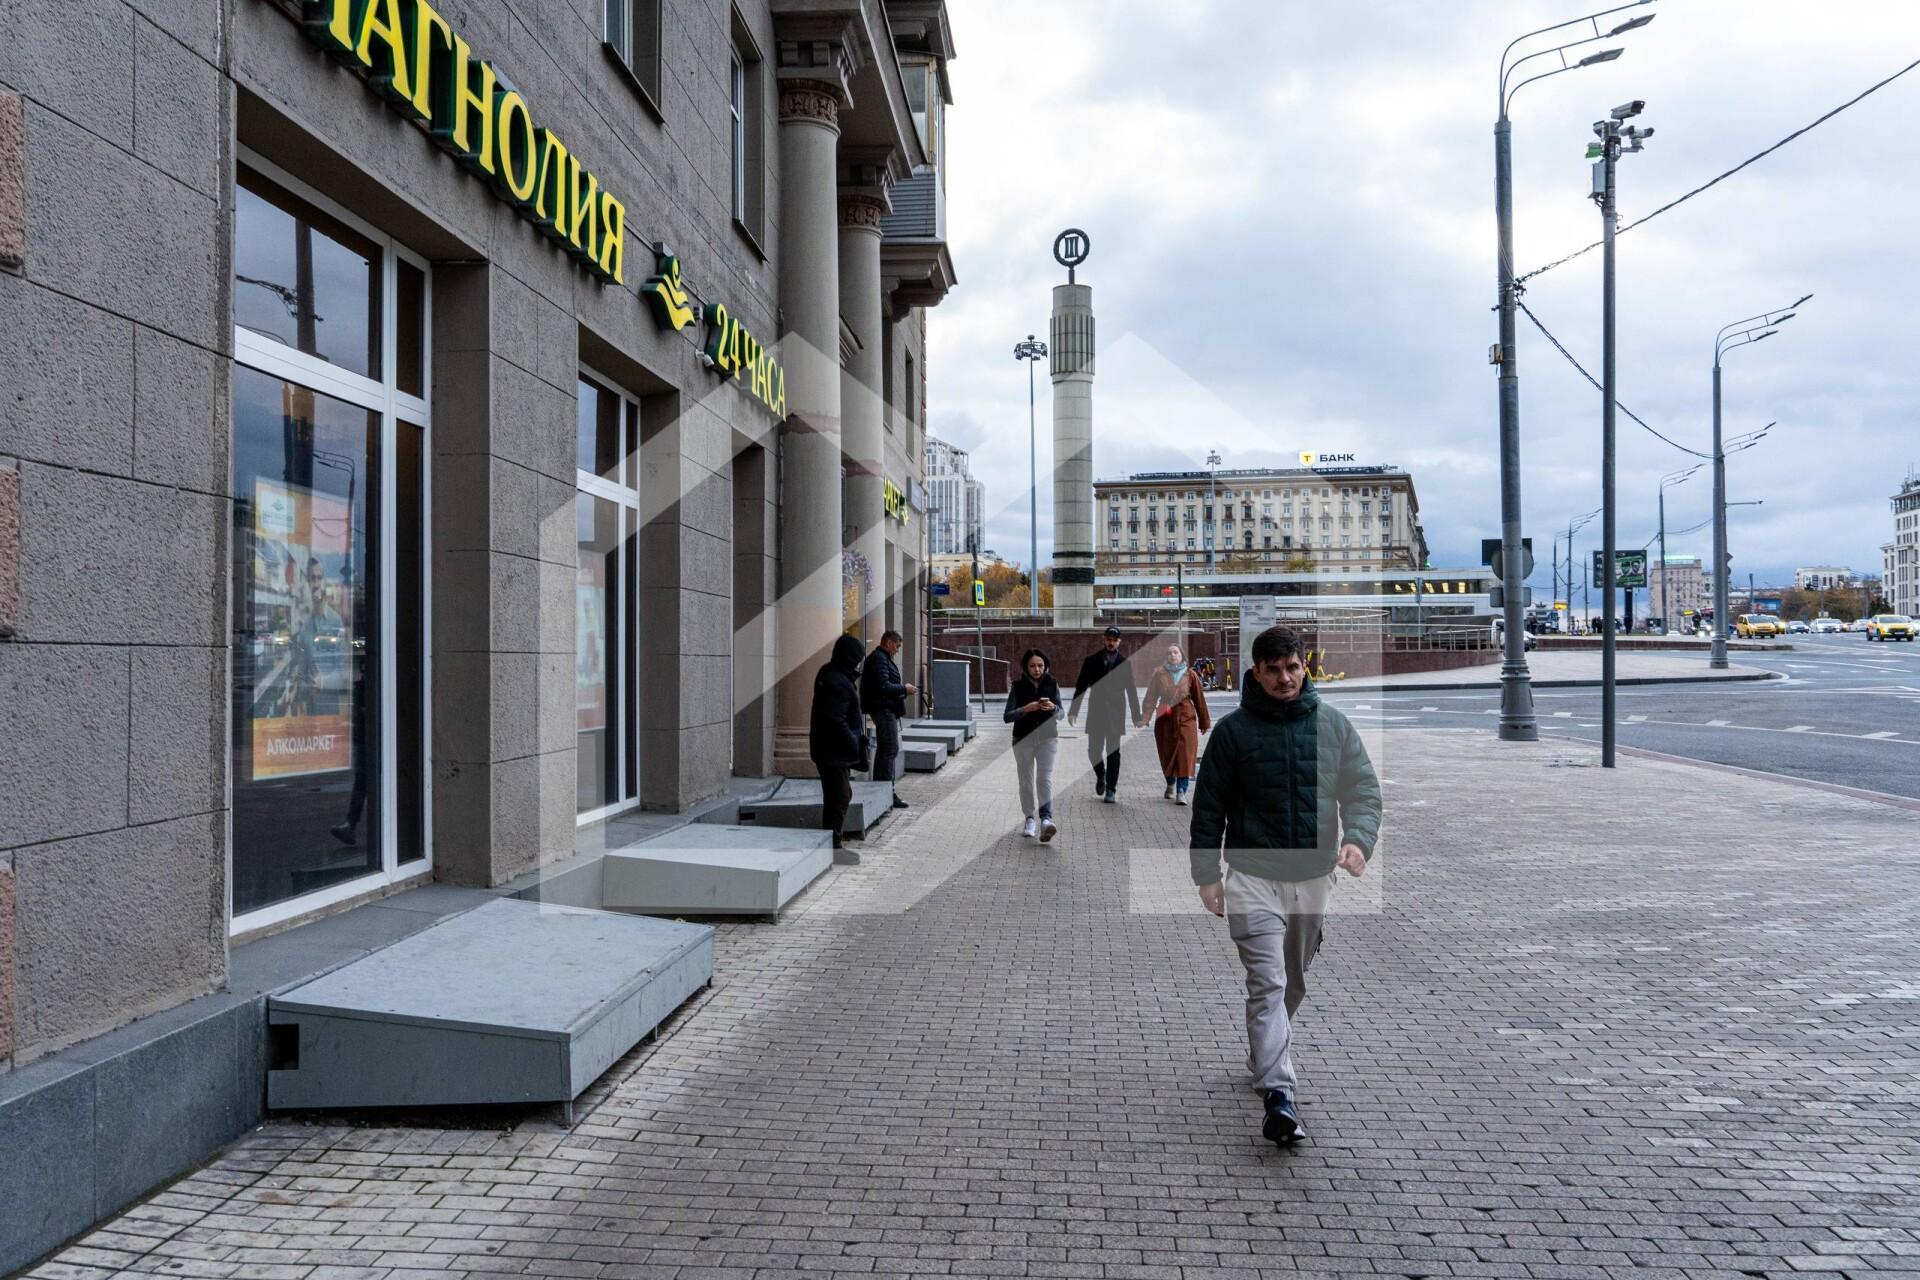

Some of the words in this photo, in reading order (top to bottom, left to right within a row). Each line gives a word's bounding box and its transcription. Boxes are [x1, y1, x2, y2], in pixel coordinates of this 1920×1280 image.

[328, 0, 625, 285] АГНОЛИЯ
[716, 303, 741, 380] 24
[744, 329, 787, 422] ЧАСА
[1319, 453, 1356, 462] БАНК
[266, 735, 336, 756] АЛКОМАРКЕТ
